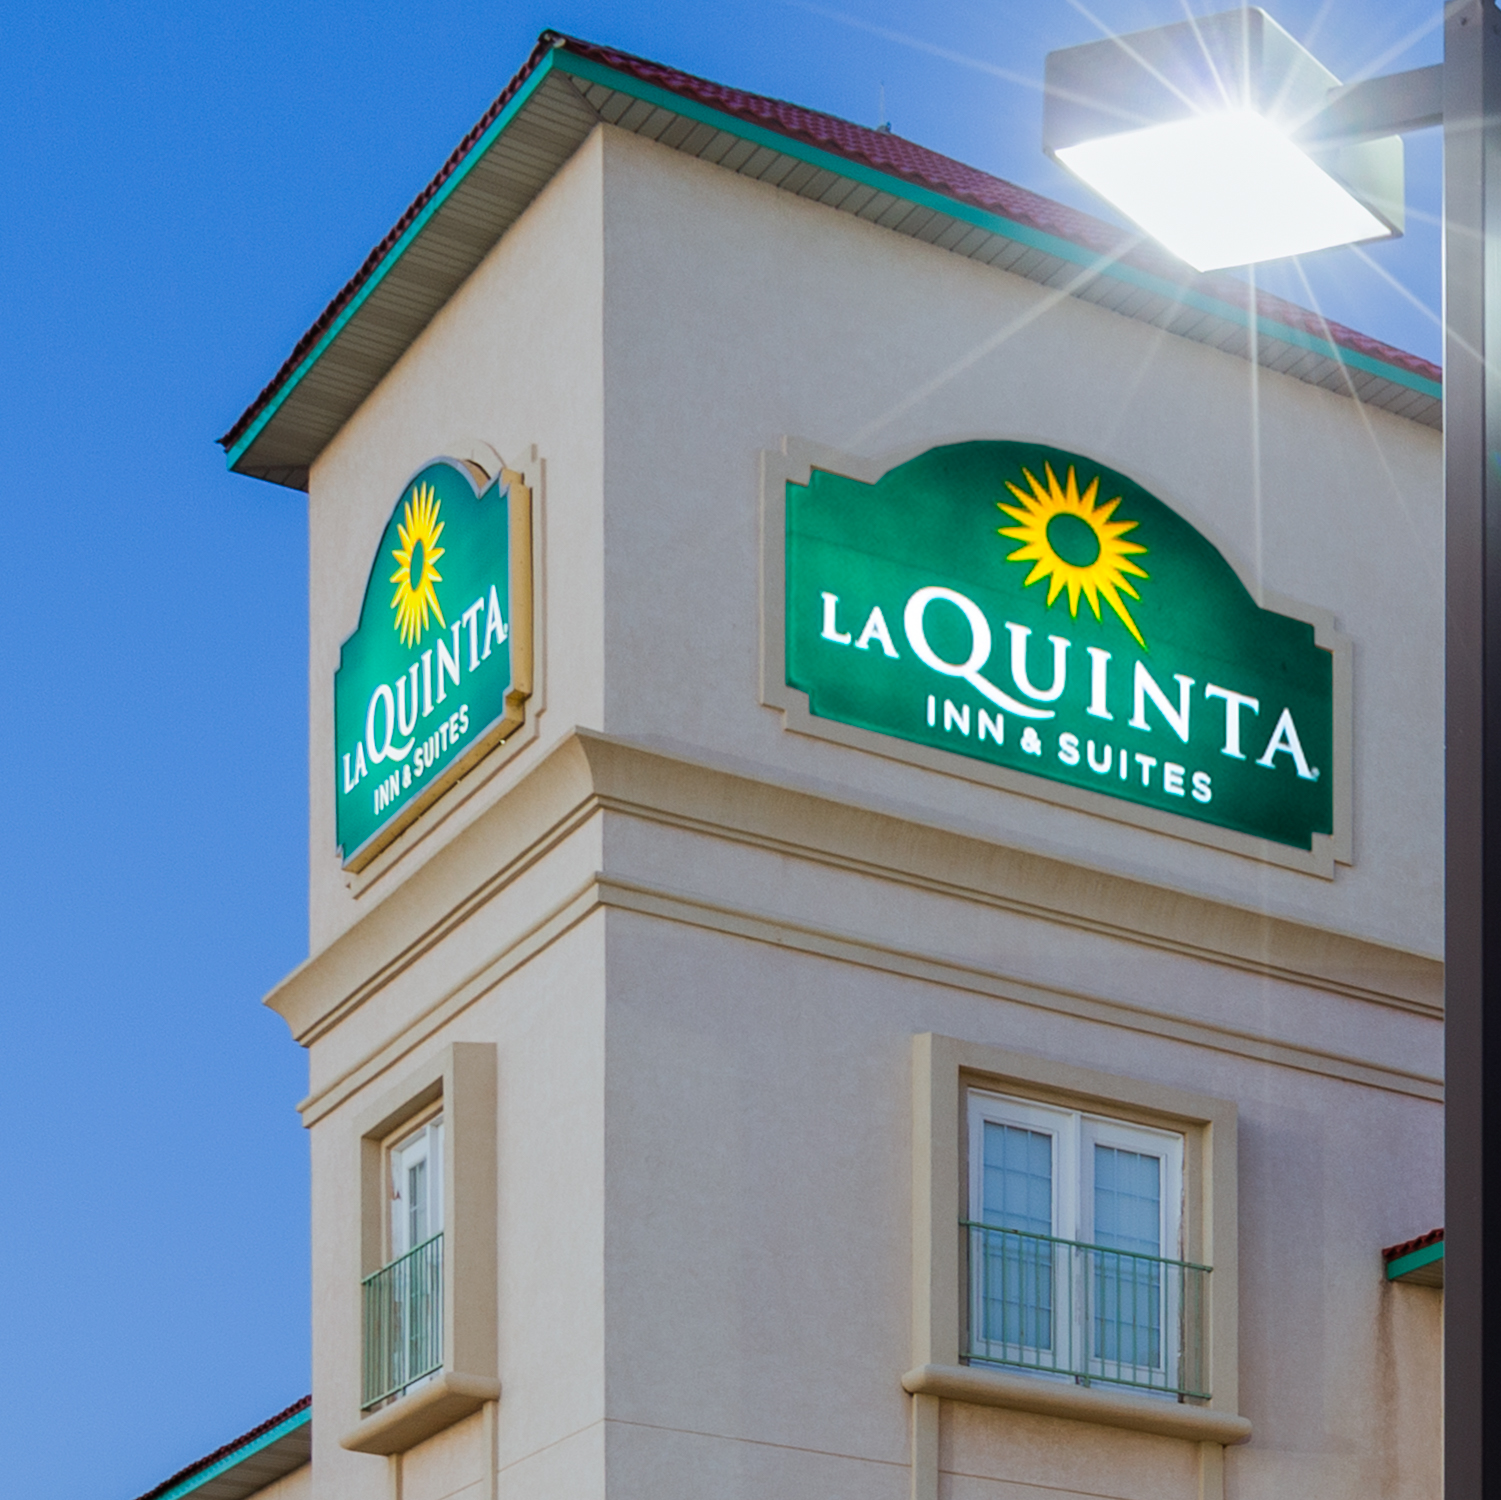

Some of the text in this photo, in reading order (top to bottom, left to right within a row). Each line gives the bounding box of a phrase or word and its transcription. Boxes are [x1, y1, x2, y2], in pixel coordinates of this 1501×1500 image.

[343, 584, 508, 794] LA QUINTA
[373, 704, 470, 816] INN & SUITES
[821, 585, 1319, 782] LA QUINTA
[926, 694, 1213, 804] INN & SUITES
